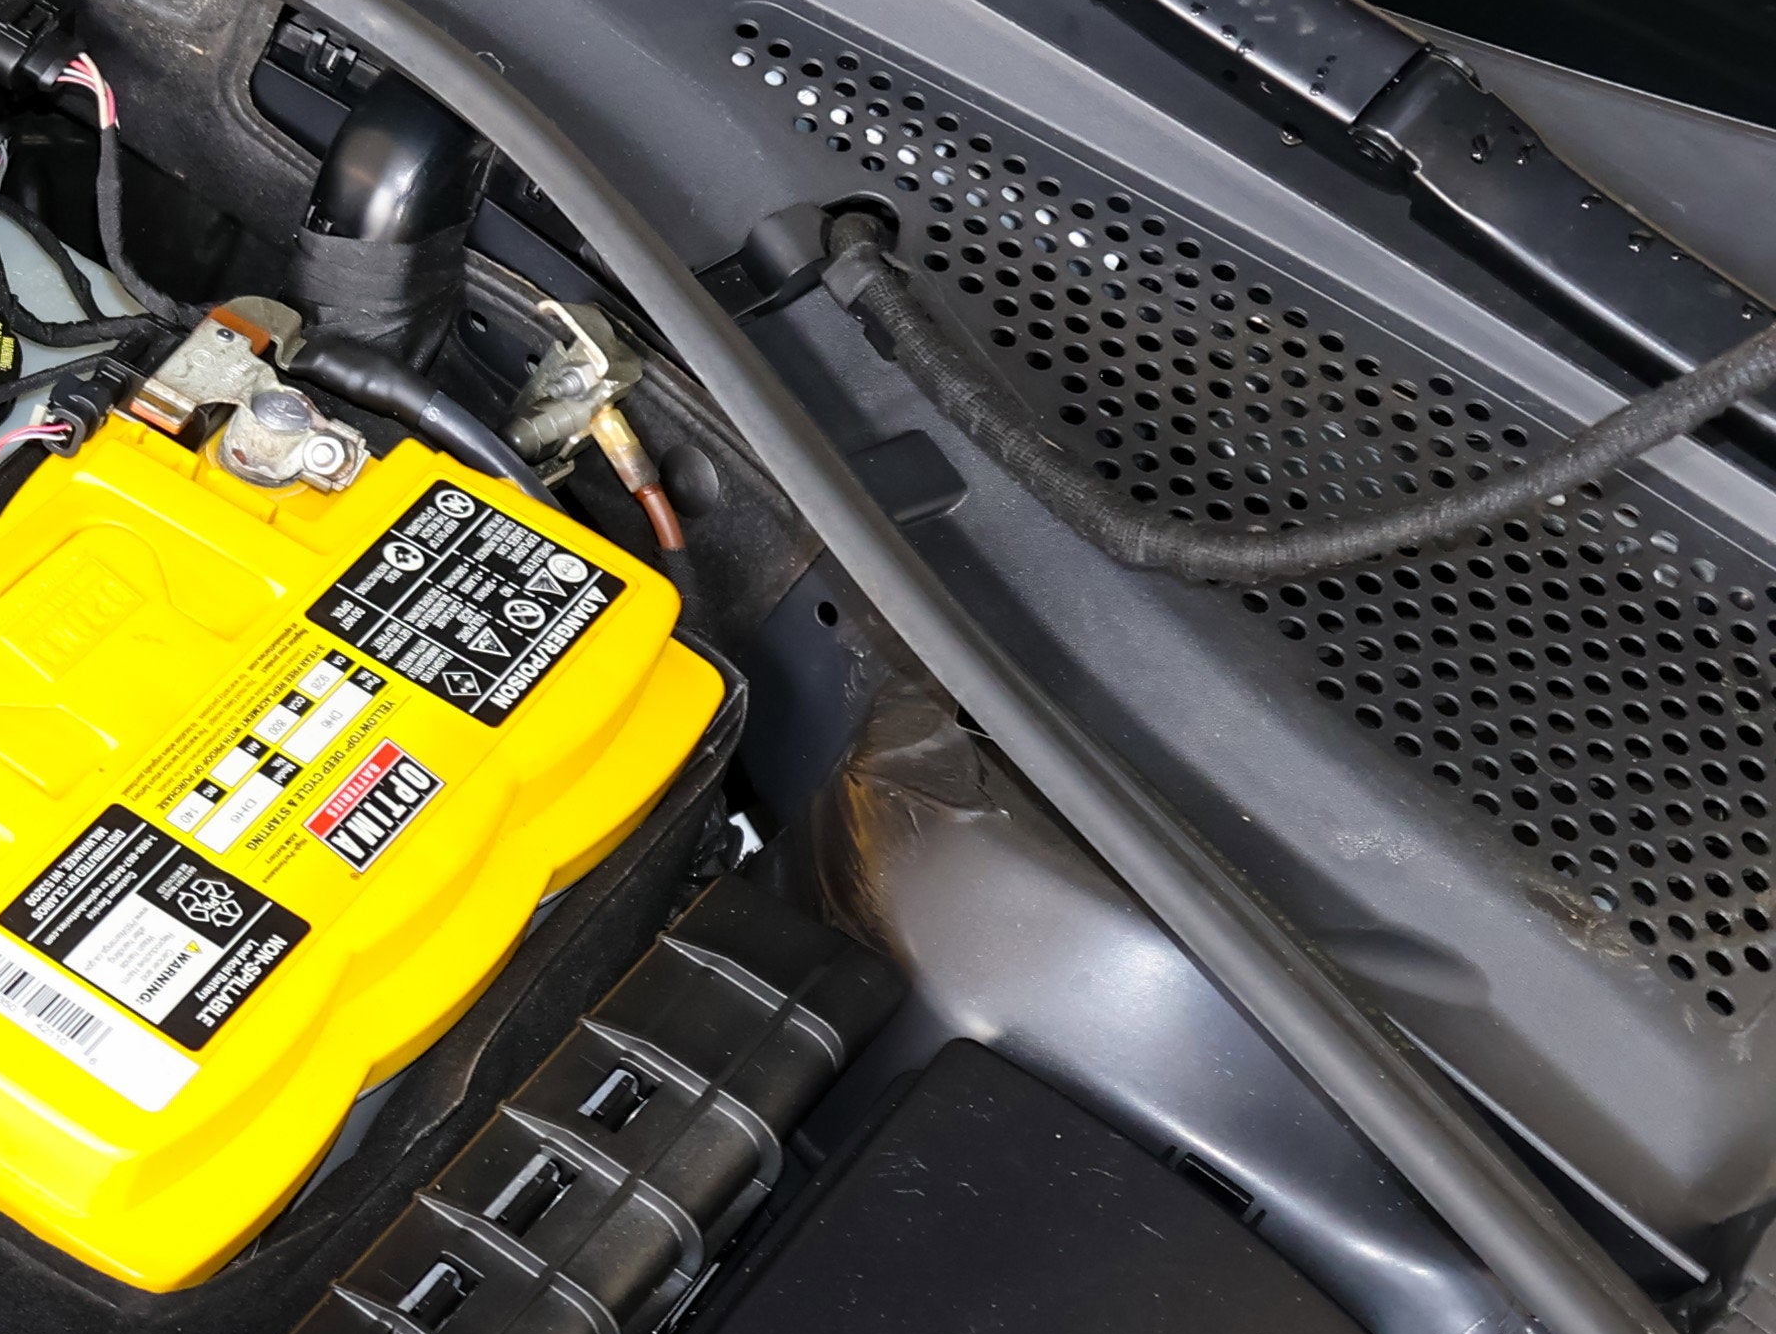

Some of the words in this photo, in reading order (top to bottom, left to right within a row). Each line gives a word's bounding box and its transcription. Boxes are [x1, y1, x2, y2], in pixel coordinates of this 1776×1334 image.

[331, 654, 346, 666] CA
[488, 597, 599, 709] DANGER/POISON
[283, 665, 303, 683] FREE
[238, 681, 287, 727] REPLACEMENT
[286, 695, 306, 711] CCA
[222, 726, 242, 744] WITH
[245, 740, 261, 754] AH
[200, 742, 226, 765] PROOF
[318, 749, 345, 774] DEEP
[192, 764, 204, 774] OF
[271, 761, 296, 783] Model
[201, 784, 218, 798] RC
[293, 771, 324, 801] CYCLE
[323, 761, 382, 818] BATTERIES
[178, 806, 199, 824] 140
[228, 797, 257, 824] DH6
[286, 799, 298, 808] &
[328, 760, 433, 861] OPTIMA
[244, 806, 292, 851] STARTING
[56, 825, 108, 873] MILWAUKEE,
[72, 828, 126, 877] DISTRIBUTED
[47, 868, 65, 882] WI
[105, 870, 138, 900] Customer
[23, 878, 55, 907] 53209
[29, 885, 68, 921] CLARIOS
[200, 895, 220, 912] Pb
[85, 896, 111, 921] Service
[235, 938, 258, 960] Lead
[135, 950, 191, 1007] WARNING:
[220, 956, 242, 976] Acid
[193, 970, 227, 1003] Battery
[194, 932, 287, 1028] NON-SPILLABLE
